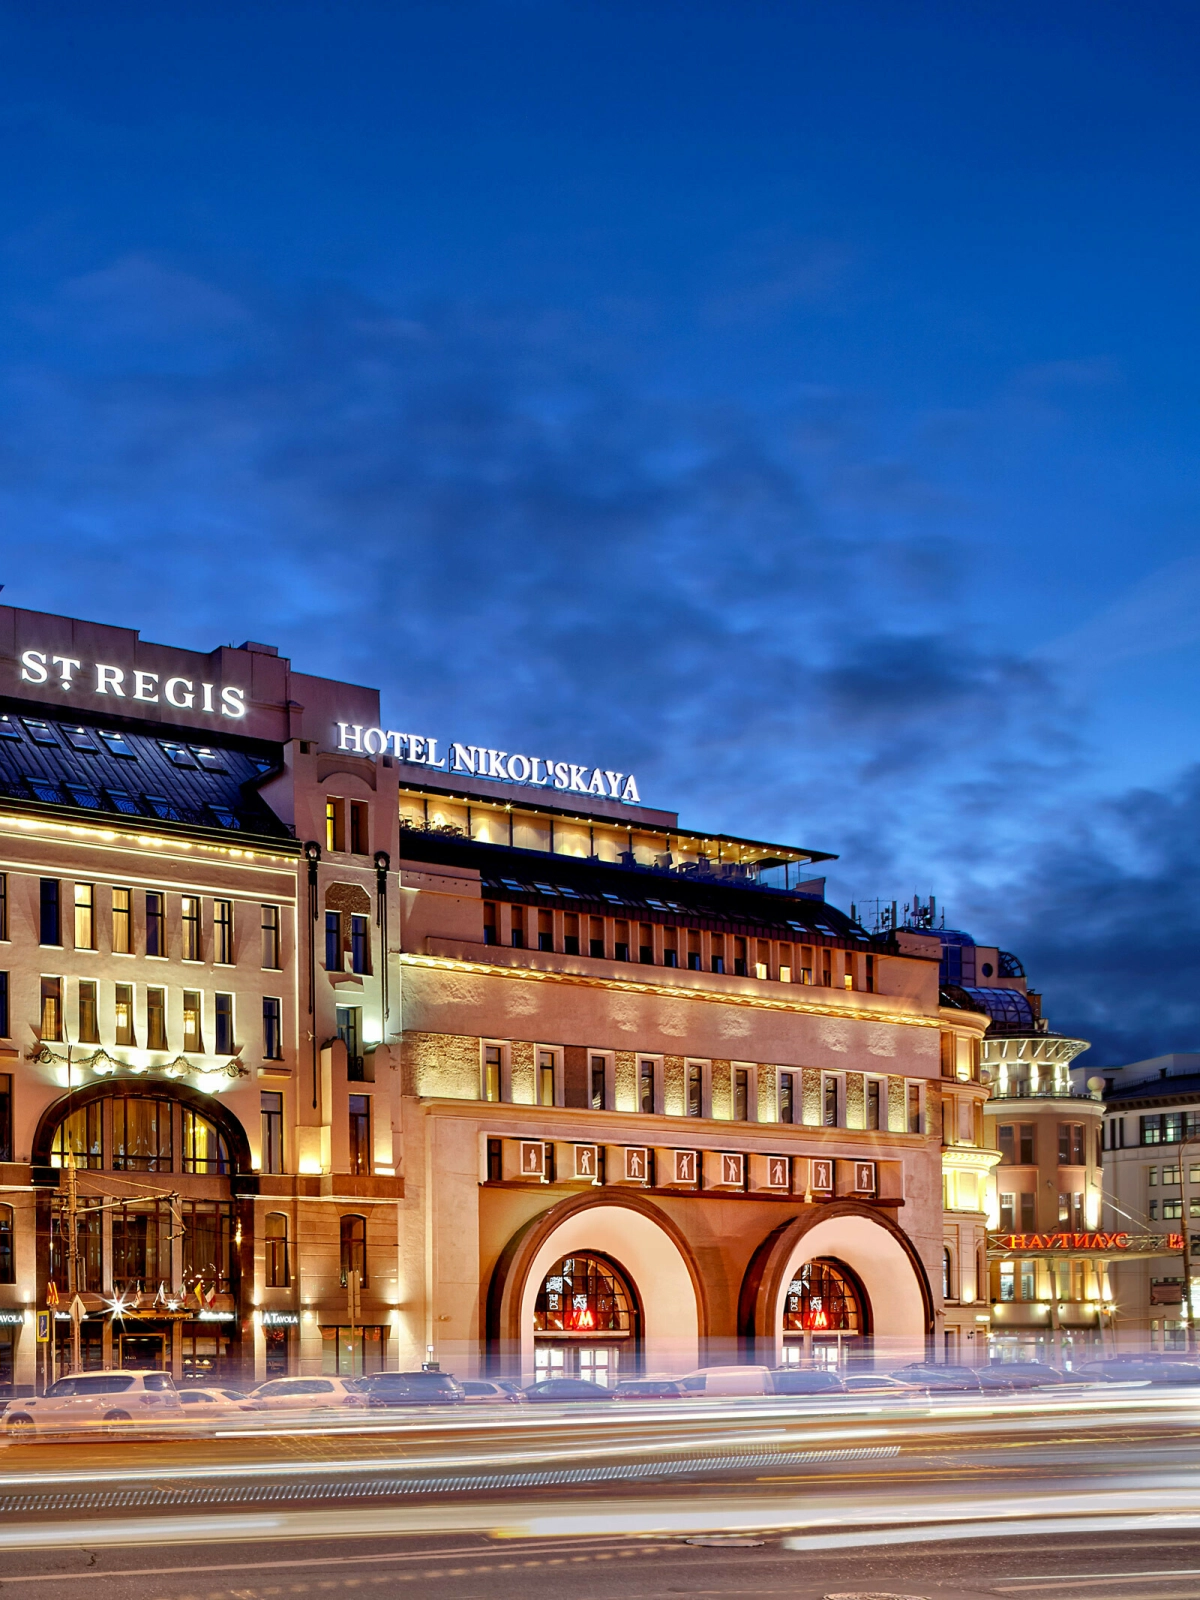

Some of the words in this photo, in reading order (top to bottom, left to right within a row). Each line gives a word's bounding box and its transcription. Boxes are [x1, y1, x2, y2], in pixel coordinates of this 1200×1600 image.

[95, 663, 245, 718] REGIS
[337, 722, 445, 767] HOTEL
[451, 743, 641, 802] NIKOL'SKAYA
[1010, 1233, 1128, 1248] НАУТИЛУС
[263, 1313, 270, 1323] A
